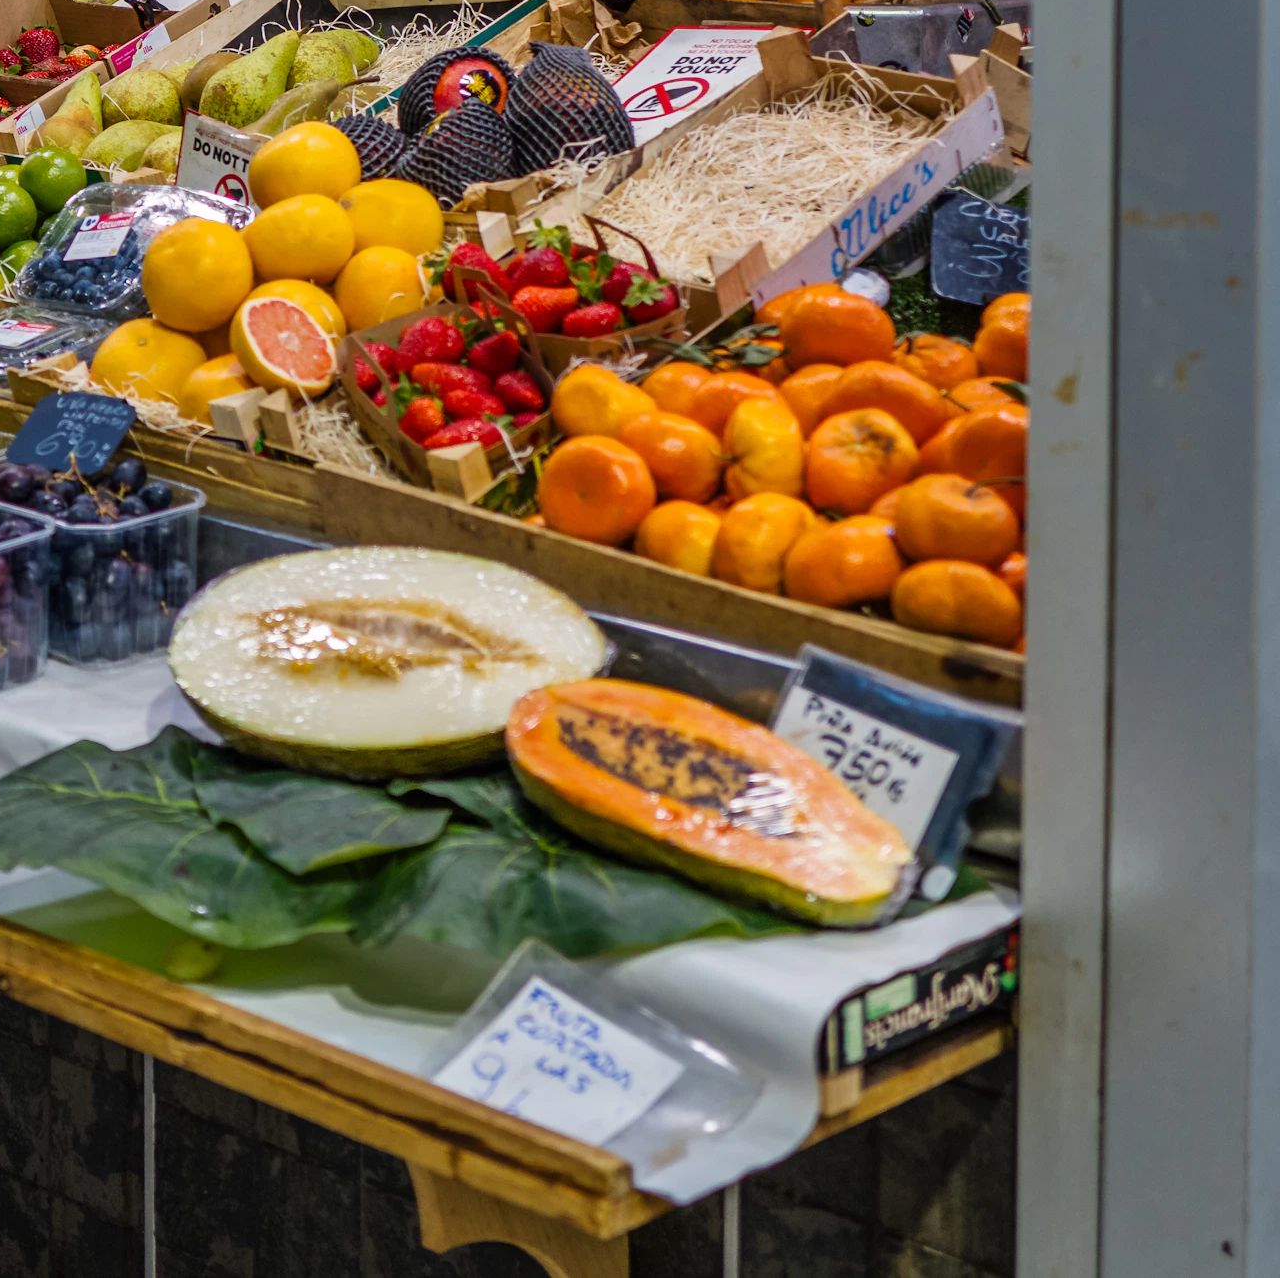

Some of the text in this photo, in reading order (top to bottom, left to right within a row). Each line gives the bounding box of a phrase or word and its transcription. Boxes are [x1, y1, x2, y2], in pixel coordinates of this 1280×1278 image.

[667, 65, 738, 75] TOUCH
[674, 56, 746, 65] DO NOT
[193, 137, 210, 156] DO
[212, 148, 238, 169] NOT
[240, 159, 250, 174] T
[97, 217, 131, 230] Cozumel
[529, 986, 602, 1042] FRUTA
[516, 1014, 632, 1091] CORTADA
